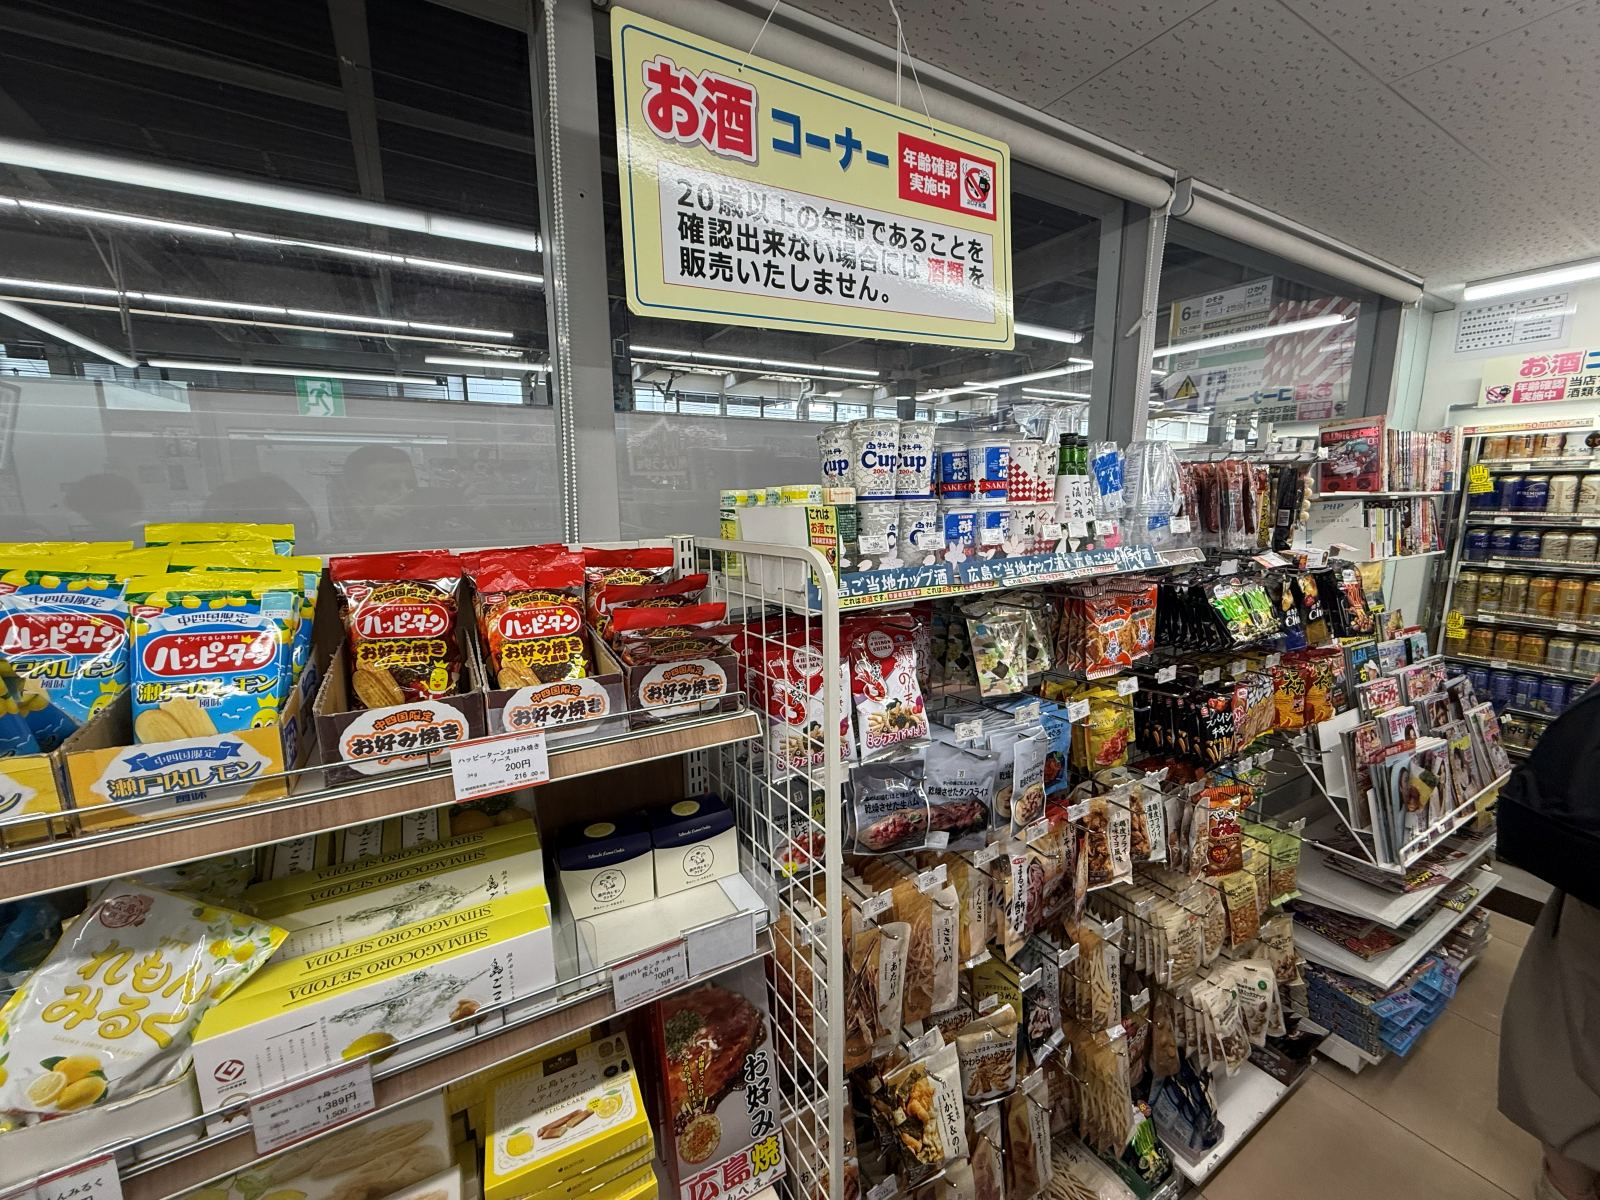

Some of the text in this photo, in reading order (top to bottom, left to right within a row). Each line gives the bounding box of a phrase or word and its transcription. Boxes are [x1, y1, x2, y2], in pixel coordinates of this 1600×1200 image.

[646, 60, 890, 172] お酒 コーナー
[903, 147, 958, 180] 年齢確認
[909, 174, 951, 199] 実施中
[677, 178, 984, 264] 20歳以上の年齢であることを
[679, 247, 890, 304] 販売いたしません。
[1248, 285, 1267, 295] ひかり
[1182, 307, 1192, 321] 6
[1520, 352, 1583, 377] お酒
[1520, 391, 1556, 401] 実施中
[861, 451, 896, 473] Cup
[809, 509, 829, 520] これは
[1025, 511, 1035, 535] 千福
[811, 523, 836, 534] お酒です。
[838, 568, 948, 596] 島ご当地カップ酒
[926, 585, 964, 594] これはお酒です。
[28, 594, 106, 607] 中四国限定
[373, 586, 428, 602] 中四国限定
[510, 594, 560, 606] 中四国限定
[843, 594, 888, 606] これはお酒です。
[177, 612, 248, 626] 中四国限定
[361, 612, 445, 636] ハッピーターン
[505, 614, 578, 636] ハッピーターン
[2, 626, 121, 649] ハッピーターン
[153, 642, 274, 671] ハッピーターン
[360, 641, 446, 659] お好み焼き
[505, 638, 583, 659] お好み焼き
[524, 654, 568, 665] ソース風味
[663, 665, 704, 680] 中四国限定
[136, 675, 278, 705] 瀬戸内レモン
[532, 685, 581, 703] 中四国限定
[647, 677, 721, 698] お好み焼き
[199, 697, 222, 708] 風味
[513, 698, 602, 725] お好み焼き
[374, 710, 433, 730] 中四国限定
[352, 723, 461, 756] お好み焼き
[154, 749, 217, 765] 中四国限定
[458, 743, 540, 764] ハッピーターンお好み焼き
[505, 759, 531, 771] 200円
[107, 760, 262, 800] 瀬戸内レモン
[928, 786, 988, 797] 乾燥させたタンスライス
[378, 849, 487, 883] SHIMAGOCORO
[304, 905, 493, 970] SHIMAGOCORO SETODA
[77, 939, 213, 1005] れもん
[288, 928, 489, 1001] SHIMAGOCORO SETODA
[654, 967, 674, 979] 700円
[977, 992, 1018, 1000] いかうめん
[41, 984, 190, 1049] みるく
[537, 1069, 587, 1093] 広島レモン
[544, 1097, 585, 1115] STICK CAKE
